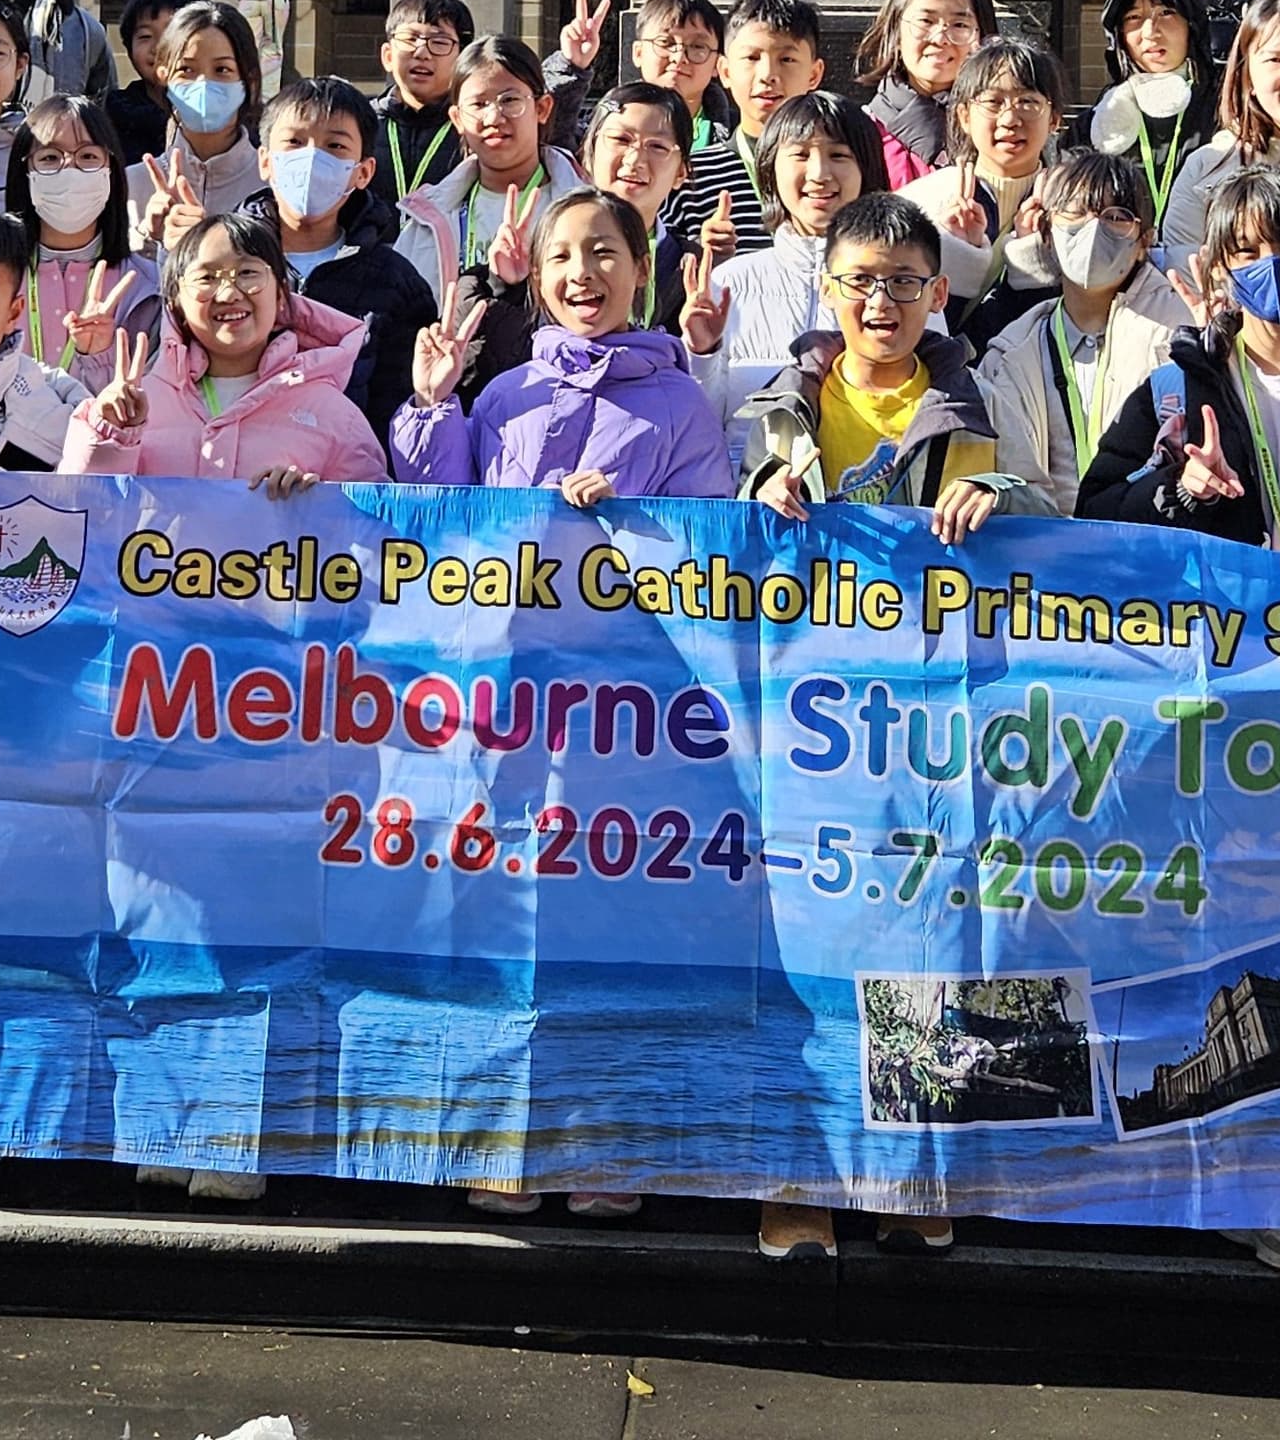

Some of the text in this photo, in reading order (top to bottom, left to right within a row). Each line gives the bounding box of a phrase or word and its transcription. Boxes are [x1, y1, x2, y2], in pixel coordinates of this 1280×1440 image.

[119, 529, 361, 603] Castle
[380, 537, 560, 609] Peak
[578, 544, 903, 630] Catholic
[922, 568, 1250, 668] Primary
[112, 641, 732, 763] Melbourne
[786, 672, 1127, 823] Study
